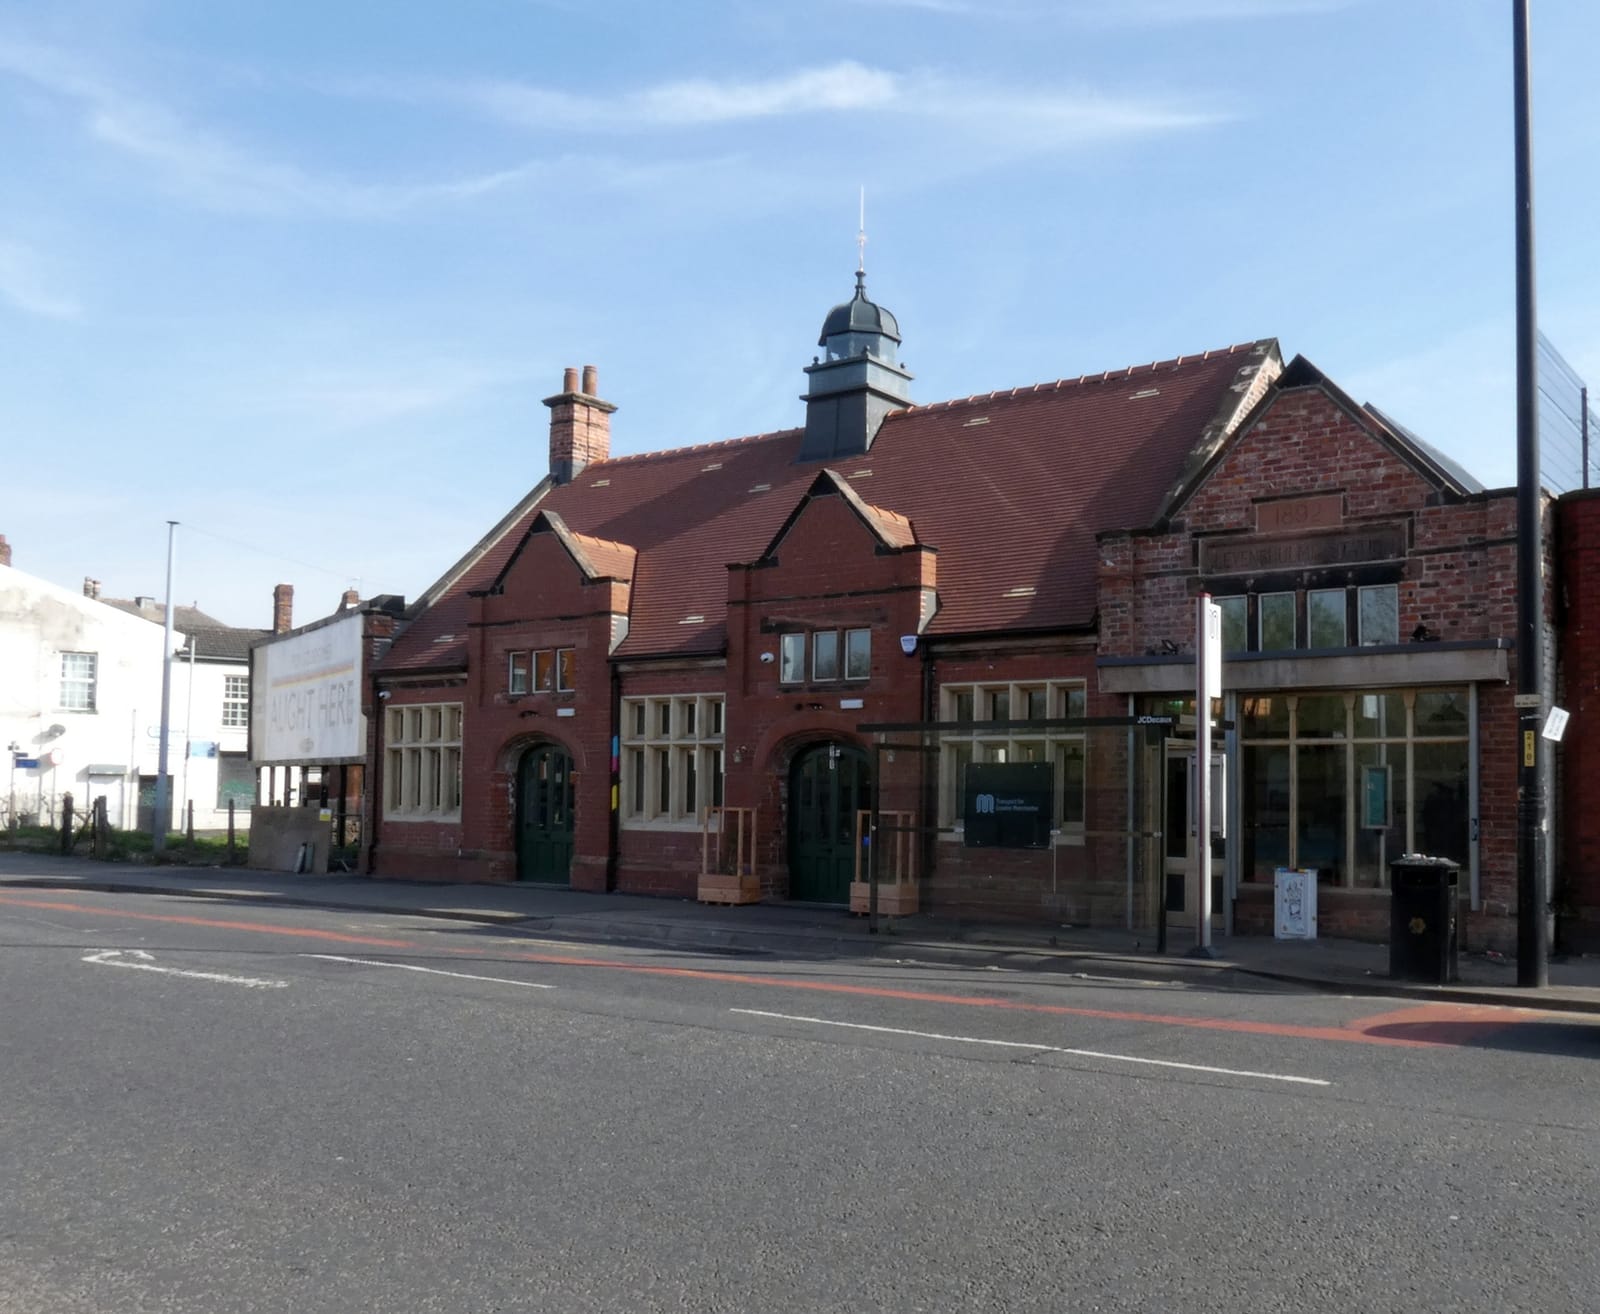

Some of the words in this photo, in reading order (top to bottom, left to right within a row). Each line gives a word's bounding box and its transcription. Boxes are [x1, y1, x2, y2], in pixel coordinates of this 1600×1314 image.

[1275, 503, 1323, 527] 1892
[271, 688, 315, 732] ALIGHT
[318, 679, 354, 728] HERE
[1137, 716, 1172, 724] JCDecaux
